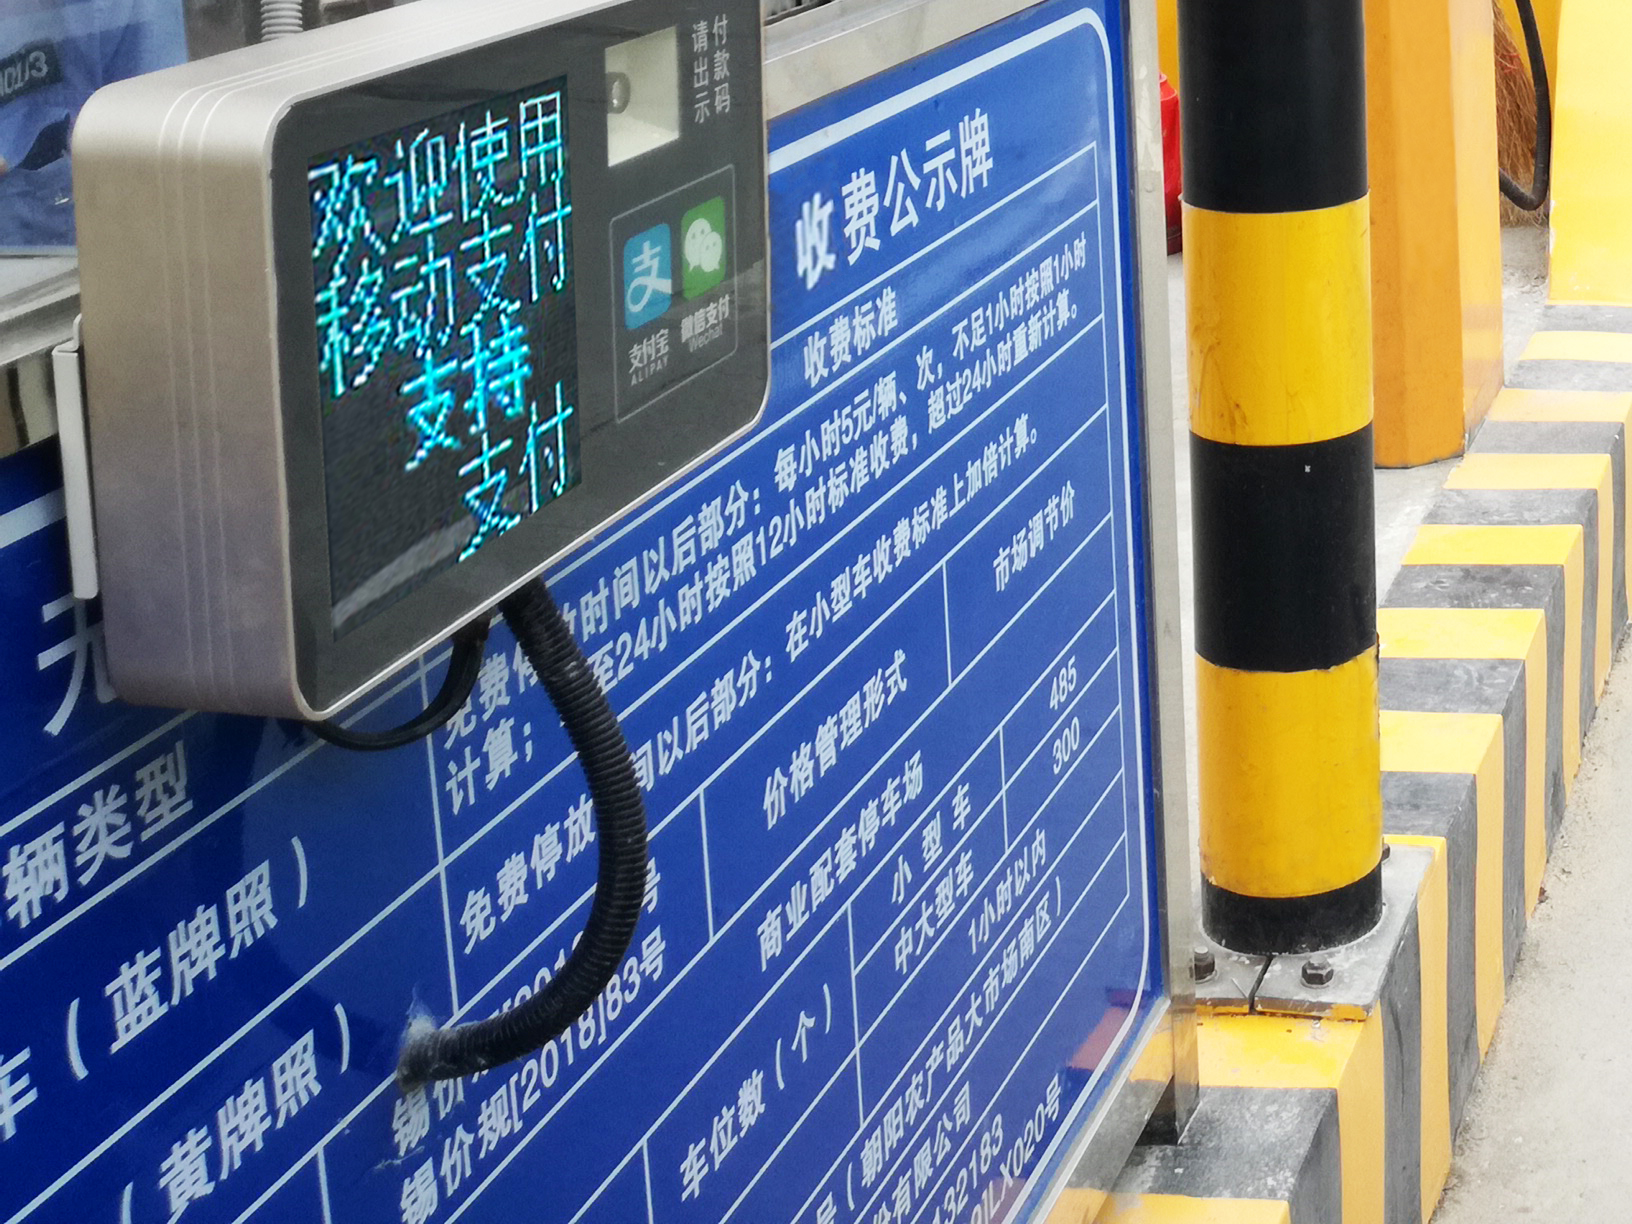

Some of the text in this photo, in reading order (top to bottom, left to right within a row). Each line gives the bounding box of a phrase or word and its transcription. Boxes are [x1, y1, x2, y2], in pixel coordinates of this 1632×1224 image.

[691, 19, 711, 124] 请出示
[712, 13, 731, 114] 付款码
[308, 91, 563, 274] 欢迎使用
[795, 107, 994, 291] 收费公示牌
[314, 174, 573, 398] 移动支付
[681, 293, 730, 343] 微信支付
[803, 285, 899, 389] 收费标准
[399, 312, 534, 472] 支持
[628, 328, 670, 375] 支付宝
[631, 356, 669, 387] ALIPAY
[458, 380, 575, 562] 支付
[993, 480, 1076, 592] 市场调节价
[763, 648, 908, 831] 价格管理形式
[1048, 655, 1078, 711] 485
[1052, 719, 1081, 776] 300
[757, 749, 924, 972] 商业配套停车场
[894, 848, 975, 975] 中大型车
[968, 827, 1047, 955] 1小时以内
